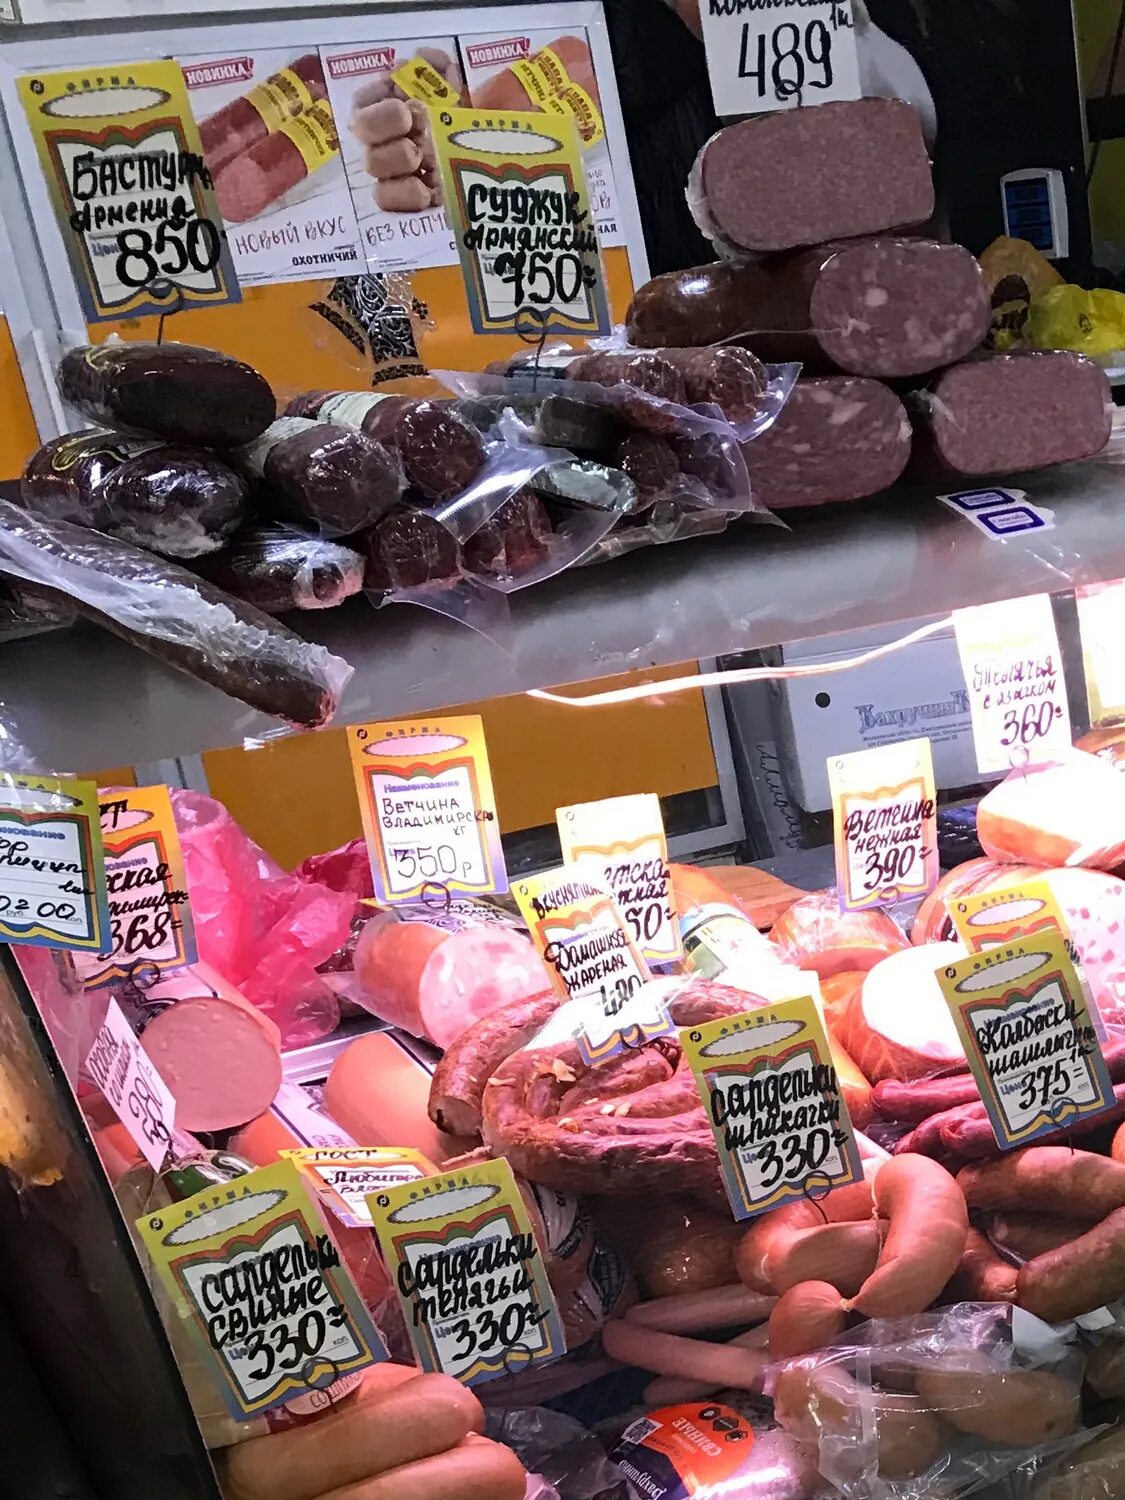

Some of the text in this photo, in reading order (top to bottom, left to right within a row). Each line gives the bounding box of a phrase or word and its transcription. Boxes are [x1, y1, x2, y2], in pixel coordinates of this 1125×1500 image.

[738, 20, 833, 97] 489
[399, 213, 447, 239] КОПЧ
[394, 845, 457, 878] 350
